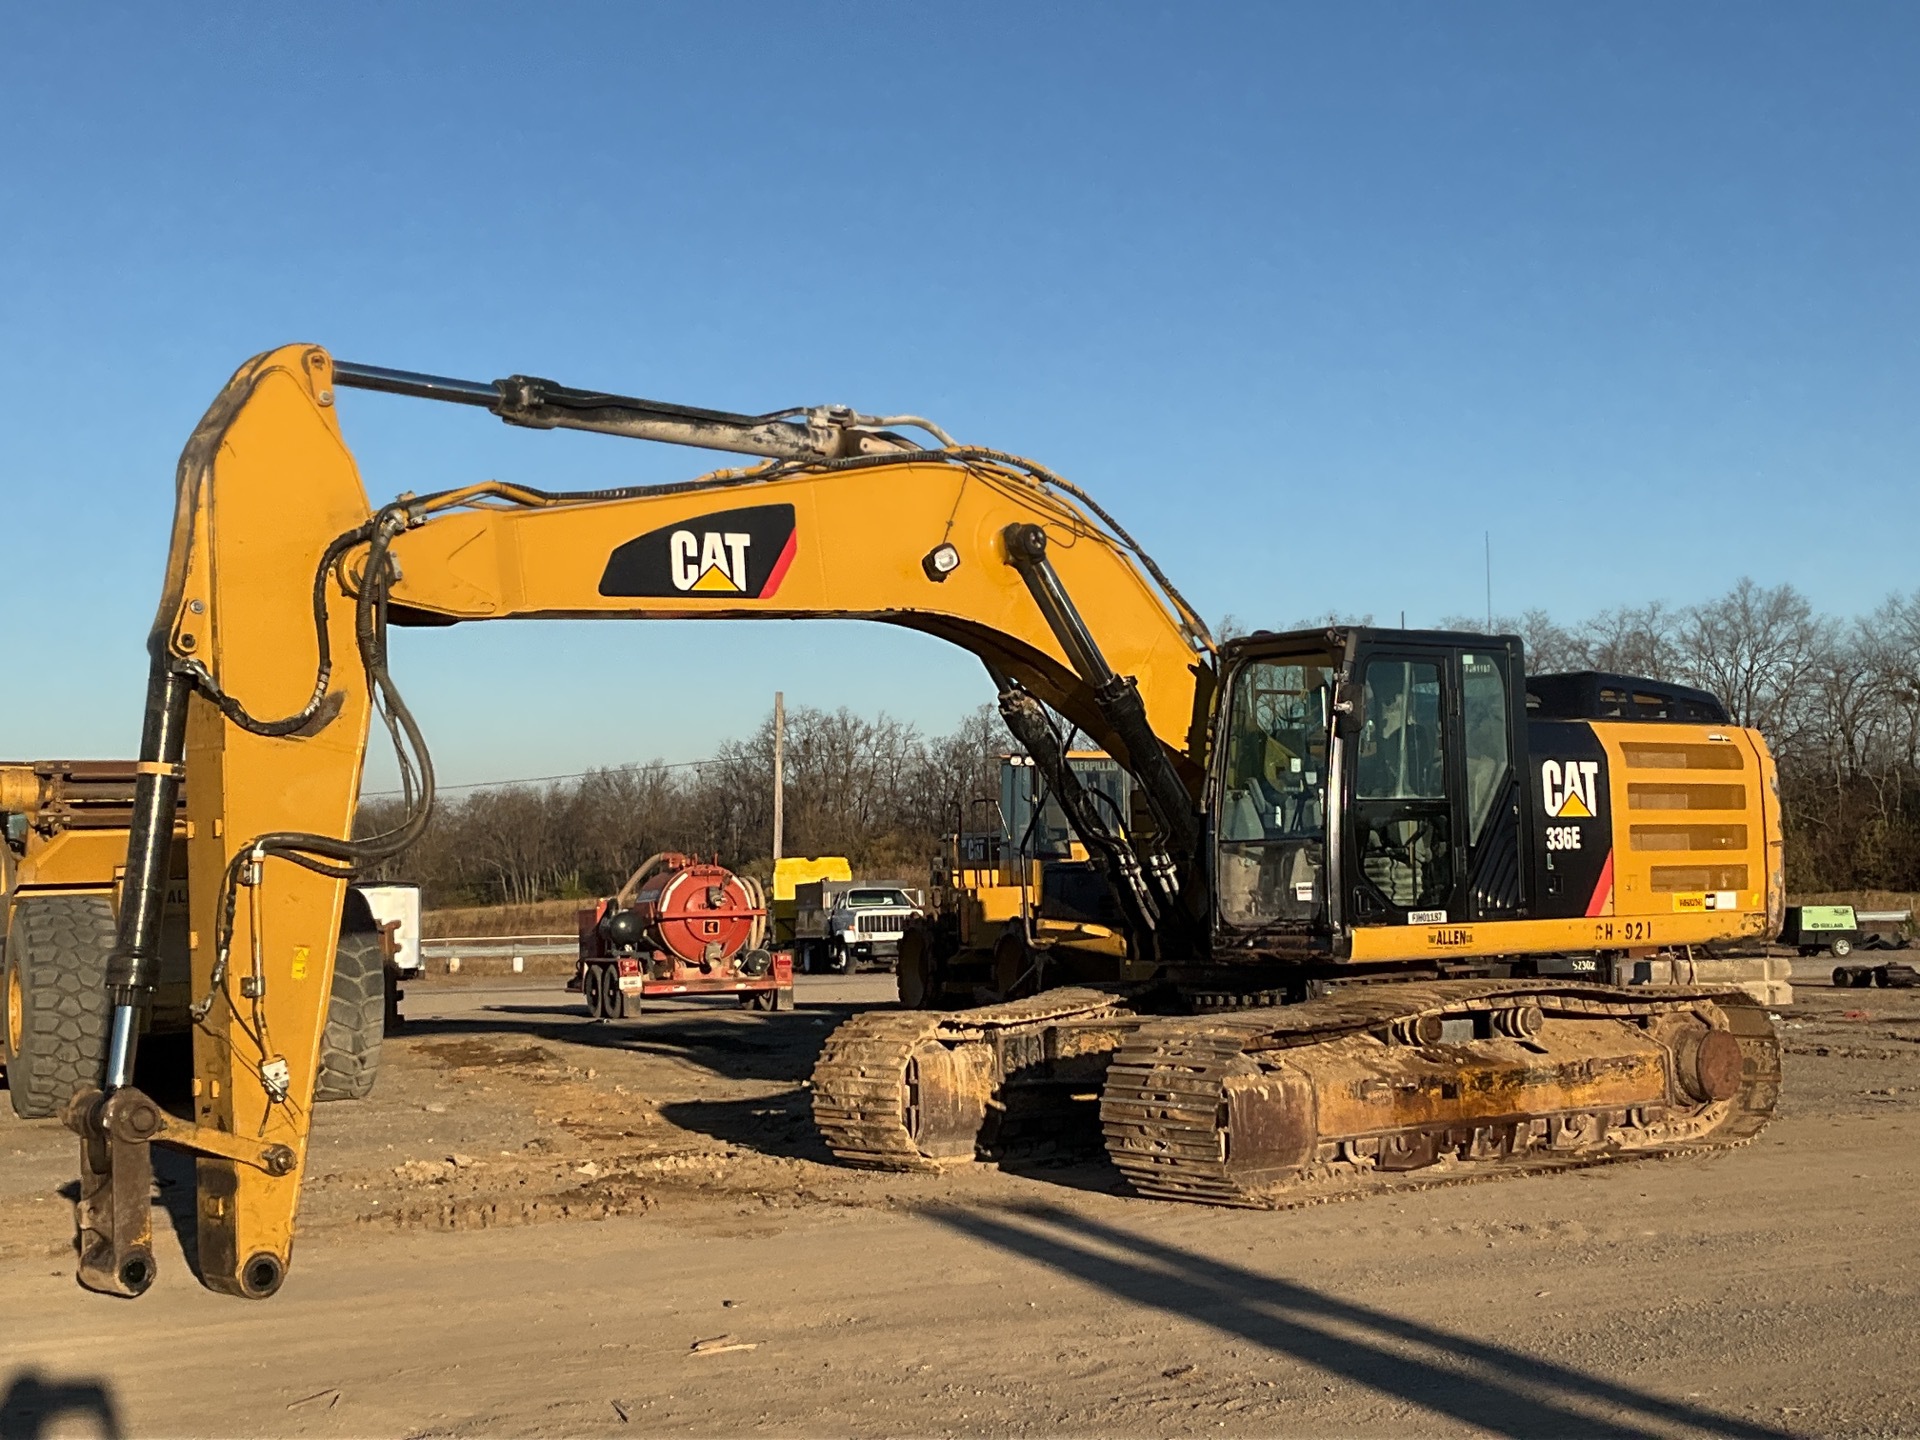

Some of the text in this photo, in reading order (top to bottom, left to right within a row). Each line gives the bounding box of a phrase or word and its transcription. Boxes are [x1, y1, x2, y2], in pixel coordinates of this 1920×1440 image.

[670, 530, 751, 592] CAT
[1542, 760, 1599, 817] CAT
[1546, 826, 1581, 850] 336E
[1436, 930, 1466, 945] ALLEN
